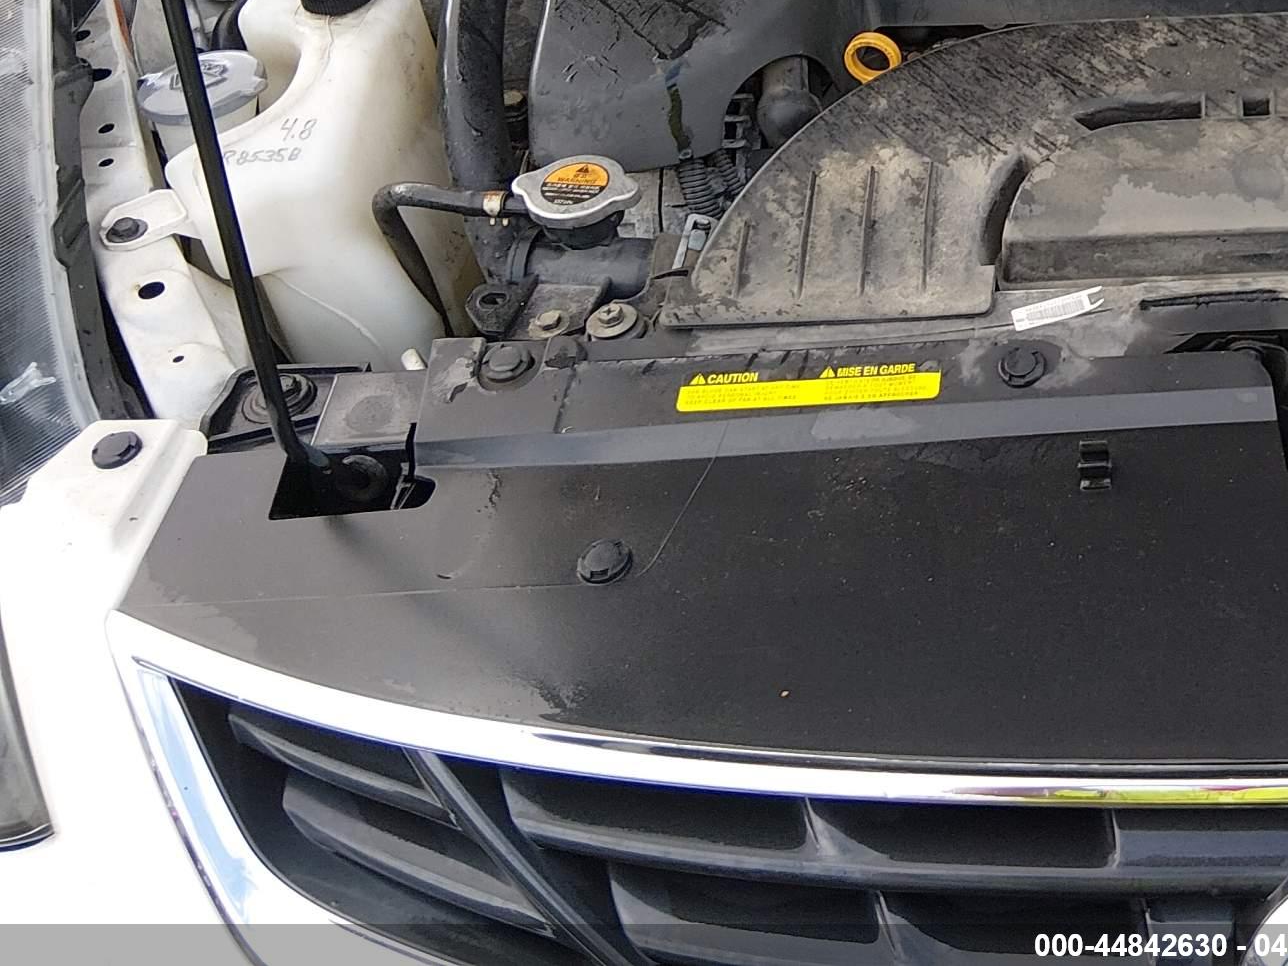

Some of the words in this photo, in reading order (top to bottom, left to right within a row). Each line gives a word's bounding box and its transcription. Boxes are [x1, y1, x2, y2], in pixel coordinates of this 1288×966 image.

[837, 367, 863, 377] MISE
[863, 365, 879, 375] EN
[880, 363, 916, 374] GARDE
[706, 372, 759, 384] CAUTION
